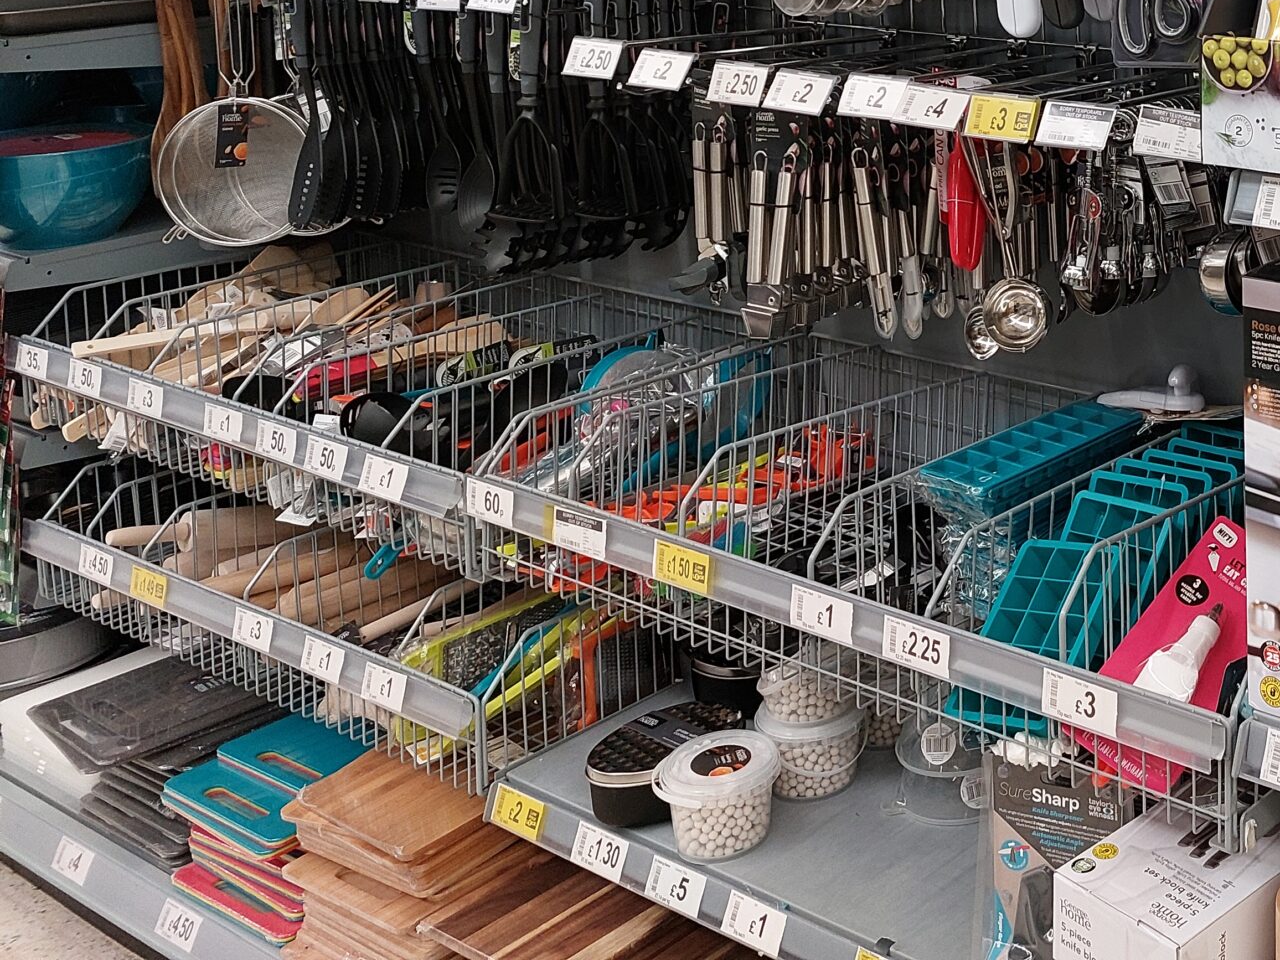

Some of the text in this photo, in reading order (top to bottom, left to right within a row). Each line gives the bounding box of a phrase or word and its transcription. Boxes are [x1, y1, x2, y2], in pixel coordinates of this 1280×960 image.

[725, 73, 759, 96] £2.50
[925, 97, 948, 118] £4
[990, 107, 1007, 131] £3
[27, 351, 41, 372] 35p
[143, 390, 153, 408] £3
[319, 447, 336, 471] 50p
[483, 490, 504, 517] 60p
[249, 621, 262, 640] £3
[902, 631, 940, 664] £2.25
[1076, 692, 1096, 718] £3
[999, 781, 1080, 812] SureSharp
[508, 802, 523, 823] £2
[69, 852, 82, 871] £4
[587, 836, 620, 868] £1.30
[670, 879, 689, 901] £5
[169, 913, 194, 939] £4.50
